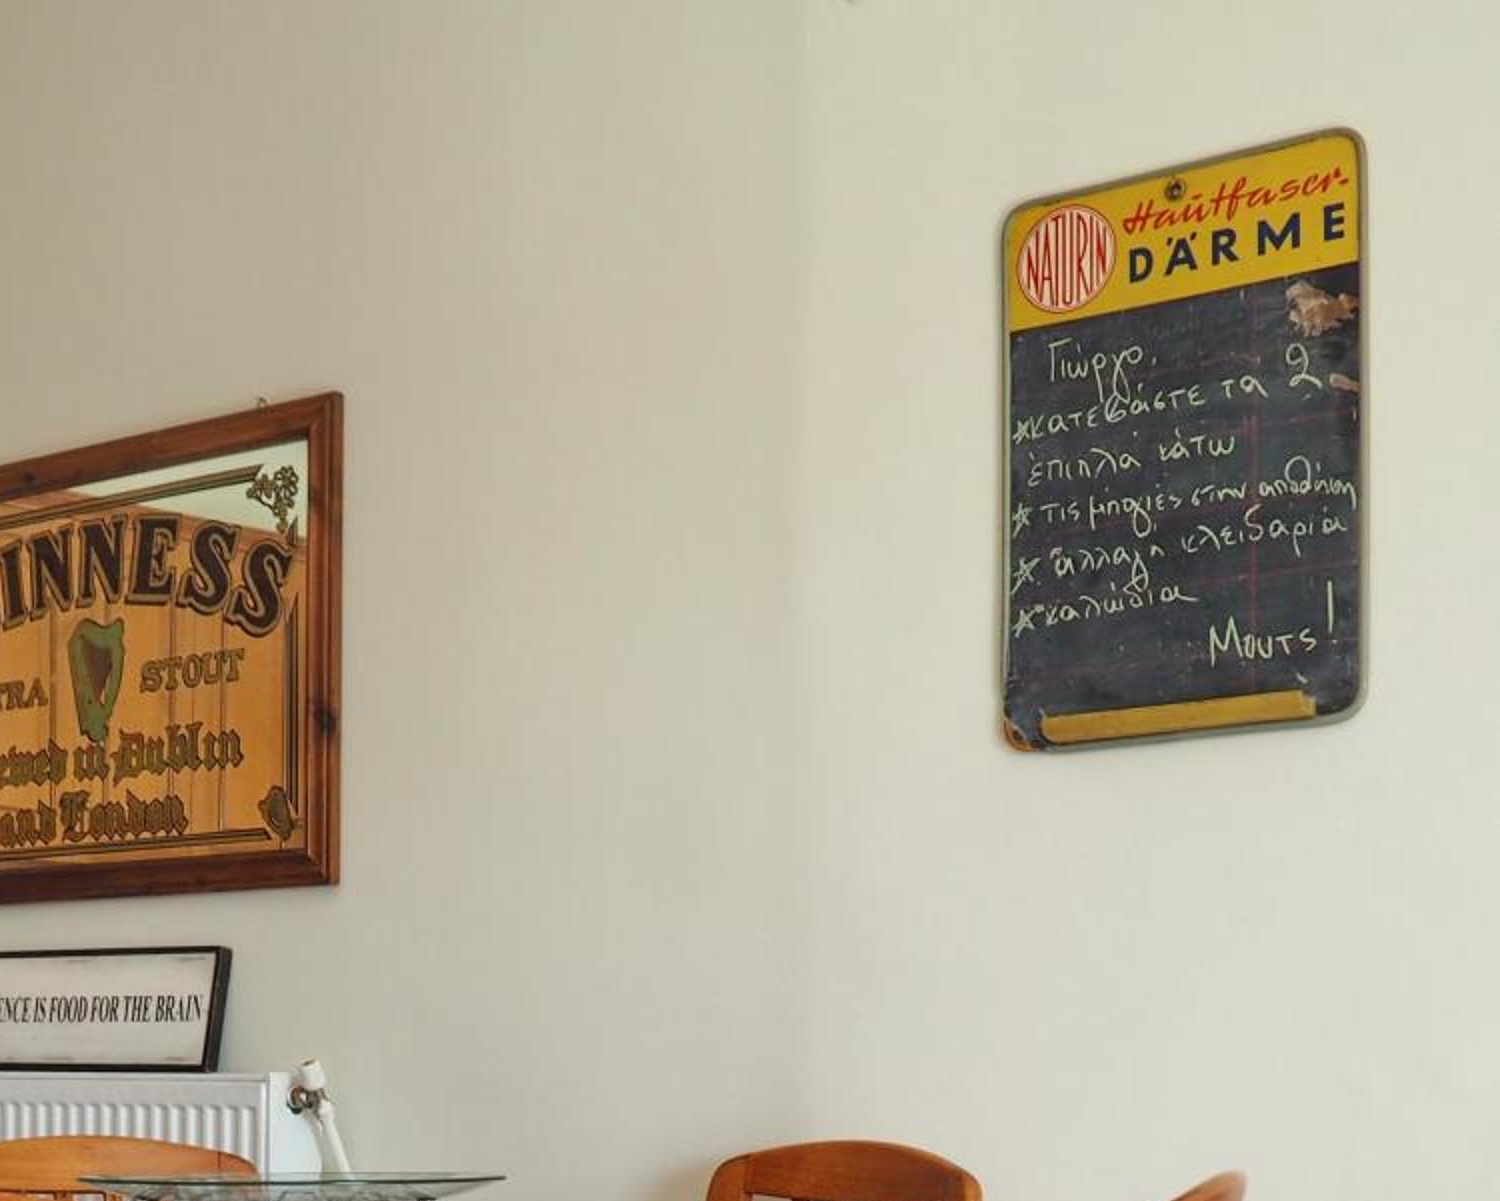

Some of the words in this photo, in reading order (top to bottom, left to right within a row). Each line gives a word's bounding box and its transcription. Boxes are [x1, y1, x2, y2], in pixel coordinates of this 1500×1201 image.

[1025, 211, 1107, 305] NATURIN
[1128, 202, 1346, 284] DÄRME
[1285, 343, 1323, 388] 2
[140, 648, 246, 694] STOUT
[112, 722, 244, 784] Dublin
[60, 790, 188, 842] London
[33, 996, 48, 1023] IS
[50, 995, 89, 1023] FOOD
[90, 995, 120, 1023] FOR
[123, 995, 153, 1022] THE
[155, 994, 203, 1023] BRAIN
